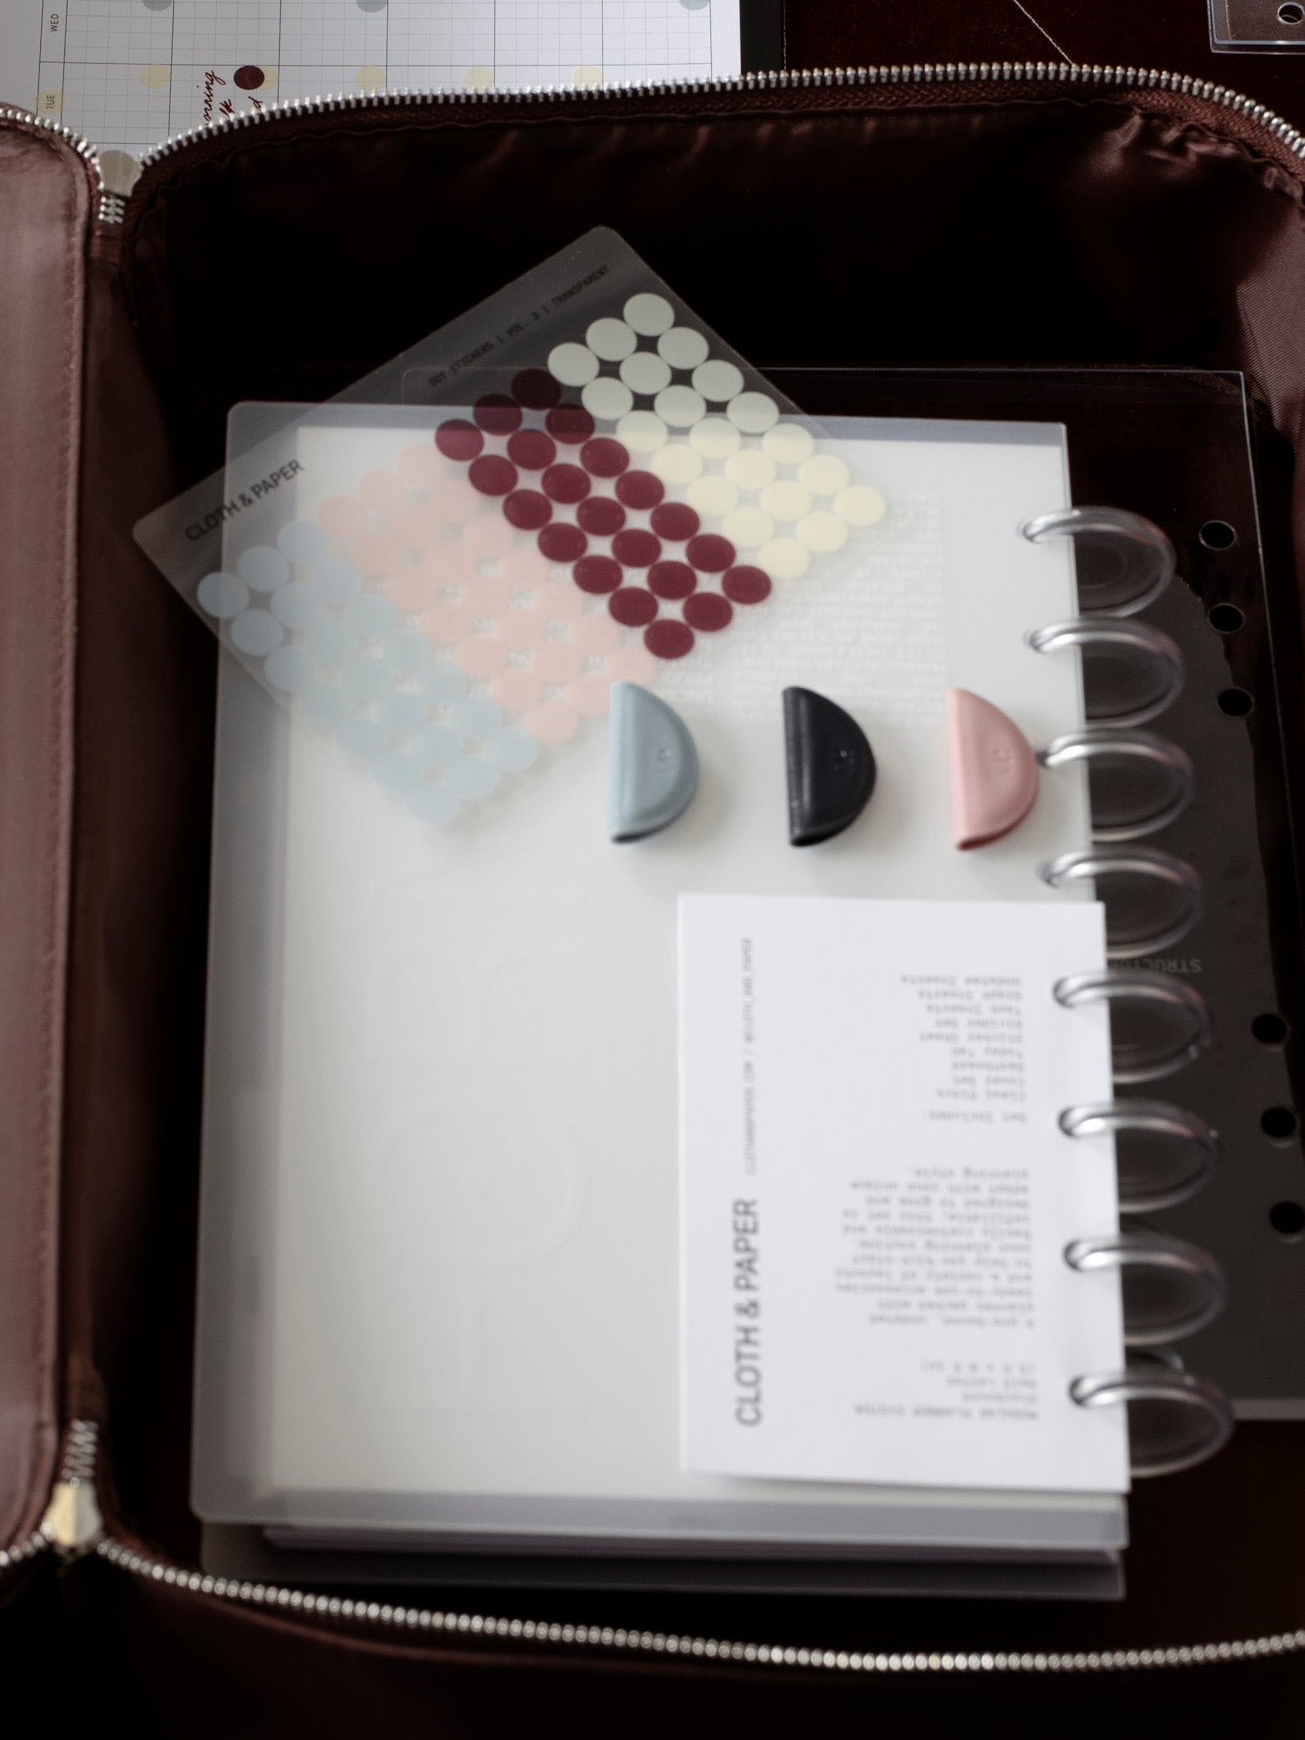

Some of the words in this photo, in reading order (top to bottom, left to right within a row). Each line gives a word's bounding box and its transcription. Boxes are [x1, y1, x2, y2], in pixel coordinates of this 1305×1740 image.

[50, 13, 59, 32] WED
[45, 94, 55, 110] TUE
[552, 265, 610, 306] TRANSPARENT
[184, 499, 239, 543] CLOTH
[239, 490, 254, 506] &
[252, 458, 304, 499] PAPER
[731, 1198, 760, 1292] PAPER
[734, 1298, 762, 1319] &
[734, 1325, 763, 1427] CLOTH
